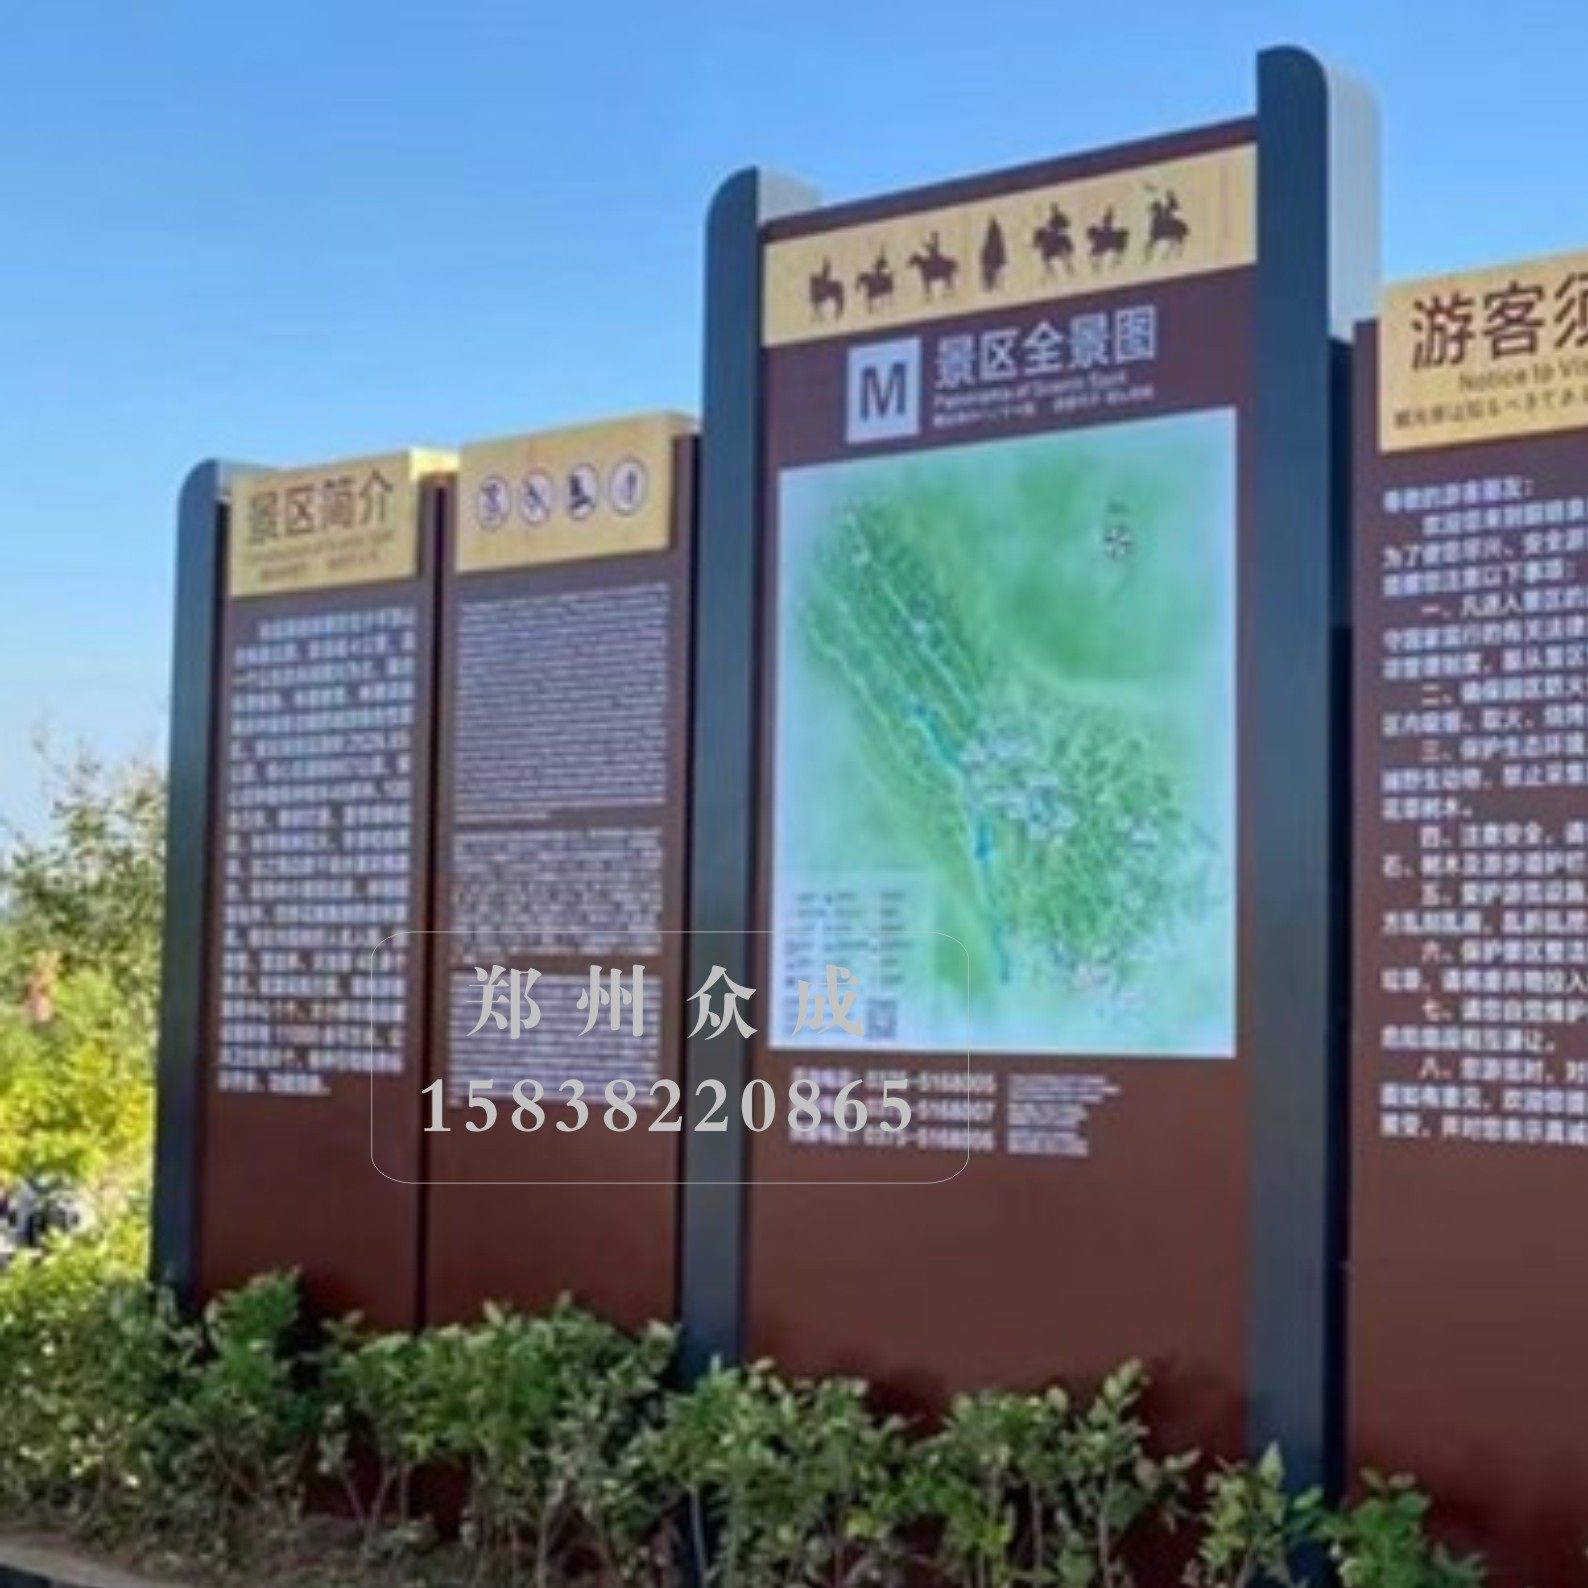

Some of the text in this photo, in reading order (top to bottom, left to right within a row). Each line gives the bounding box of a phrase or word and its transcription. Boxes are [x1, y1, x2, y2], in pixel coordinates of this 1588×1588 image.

[935, 305, 1156, 390] 景区全景图
[860, 363, 905, 421] M
[248, 470, 394, 543] 景区简介
